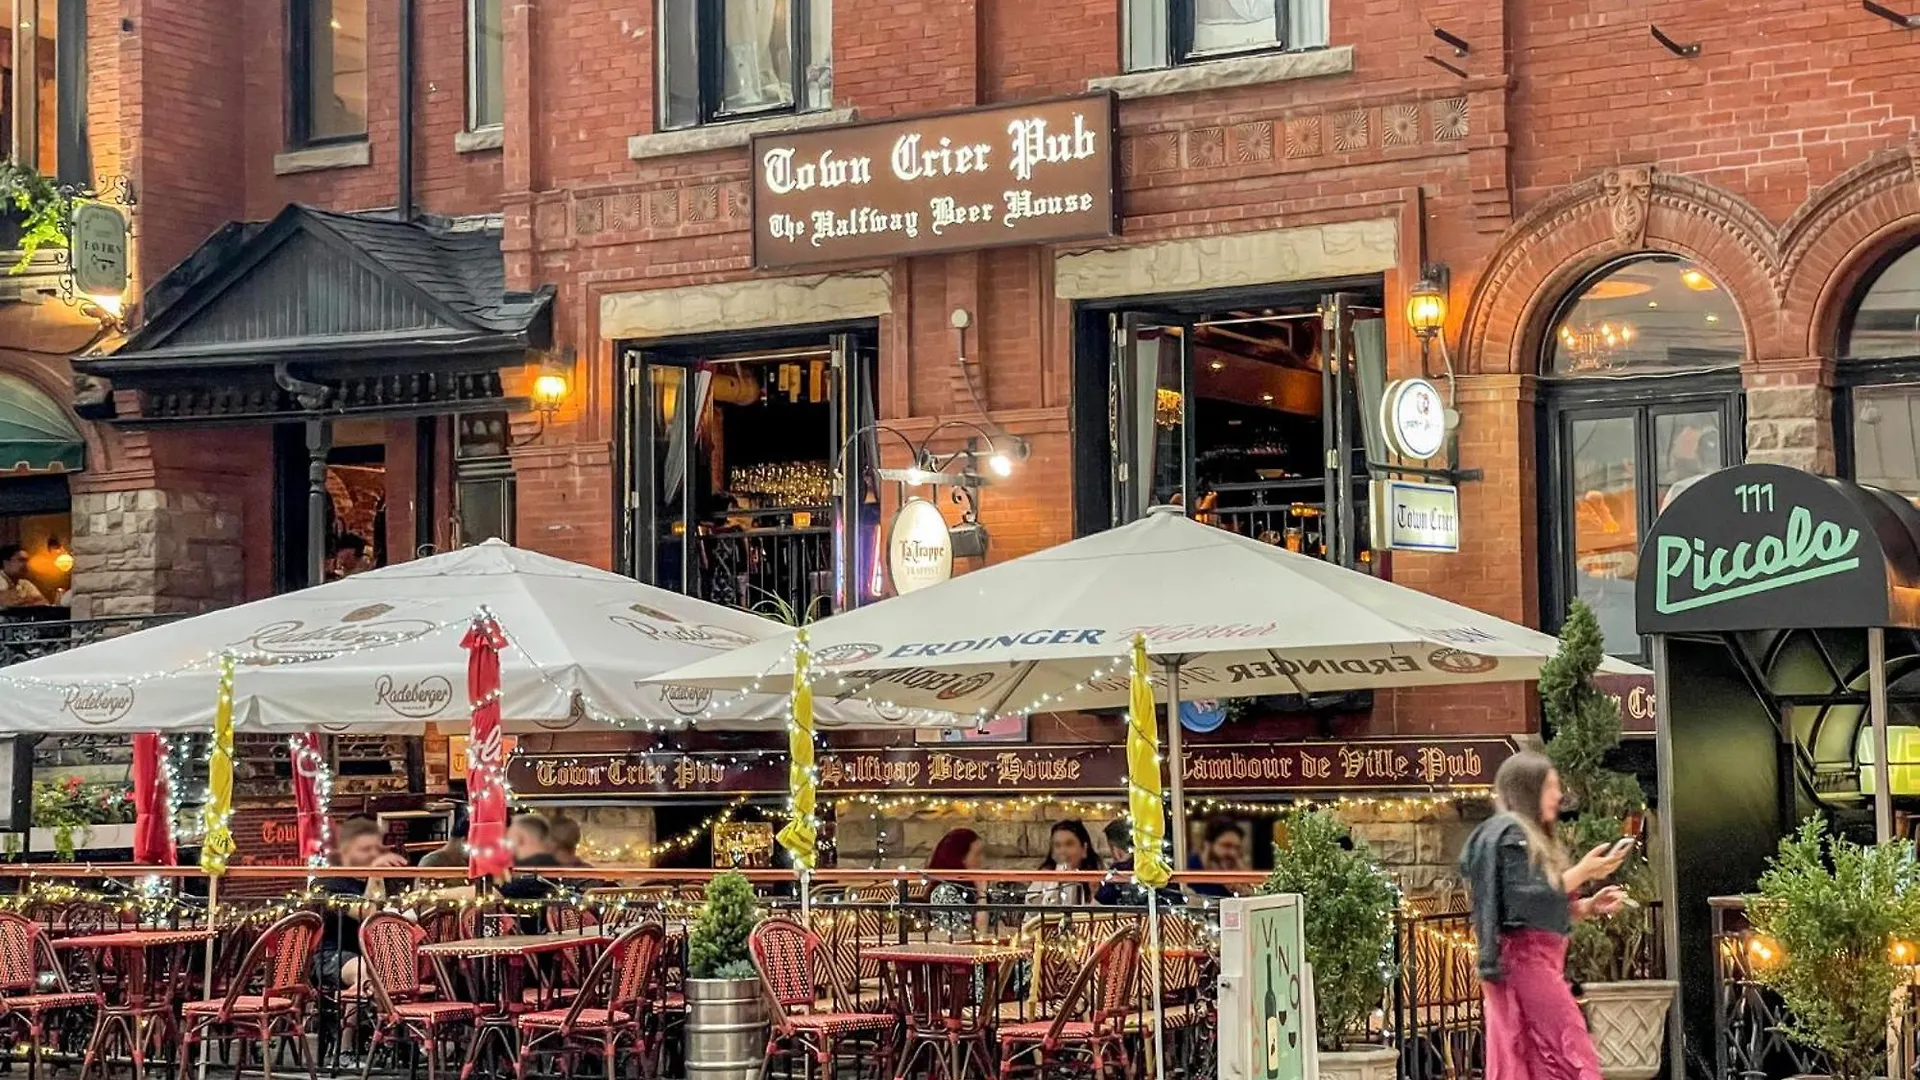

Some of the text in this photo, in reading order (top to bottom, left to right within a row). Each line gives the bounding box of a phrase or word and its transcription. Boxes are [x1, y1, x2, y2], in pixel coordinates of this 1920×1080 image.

[764, 112, 1096, 194] Town Crier Pub
[769, 190, 1093, 247] The Halfway Beer House
[1735, 483, 1774, 512] 111
[1397, 503, 1428, 529] Town
[1656, 506, 1859, 614] Piccolo
[888, 629, 1105, 658] ERDINGER
[60, 683, 129, 716] Radeberger
[375, 675, 448, 709] Radeberger
[536, 760, 600, 786] Town
[607, 758, 666, 786] Crier
[820, 752, 1081, 787] Halfway Beer House
[1300, 750, 1331, 778] de
[1339, 745, 1408, 780] Ville
[1416, 747, 1482, 782] Pub
